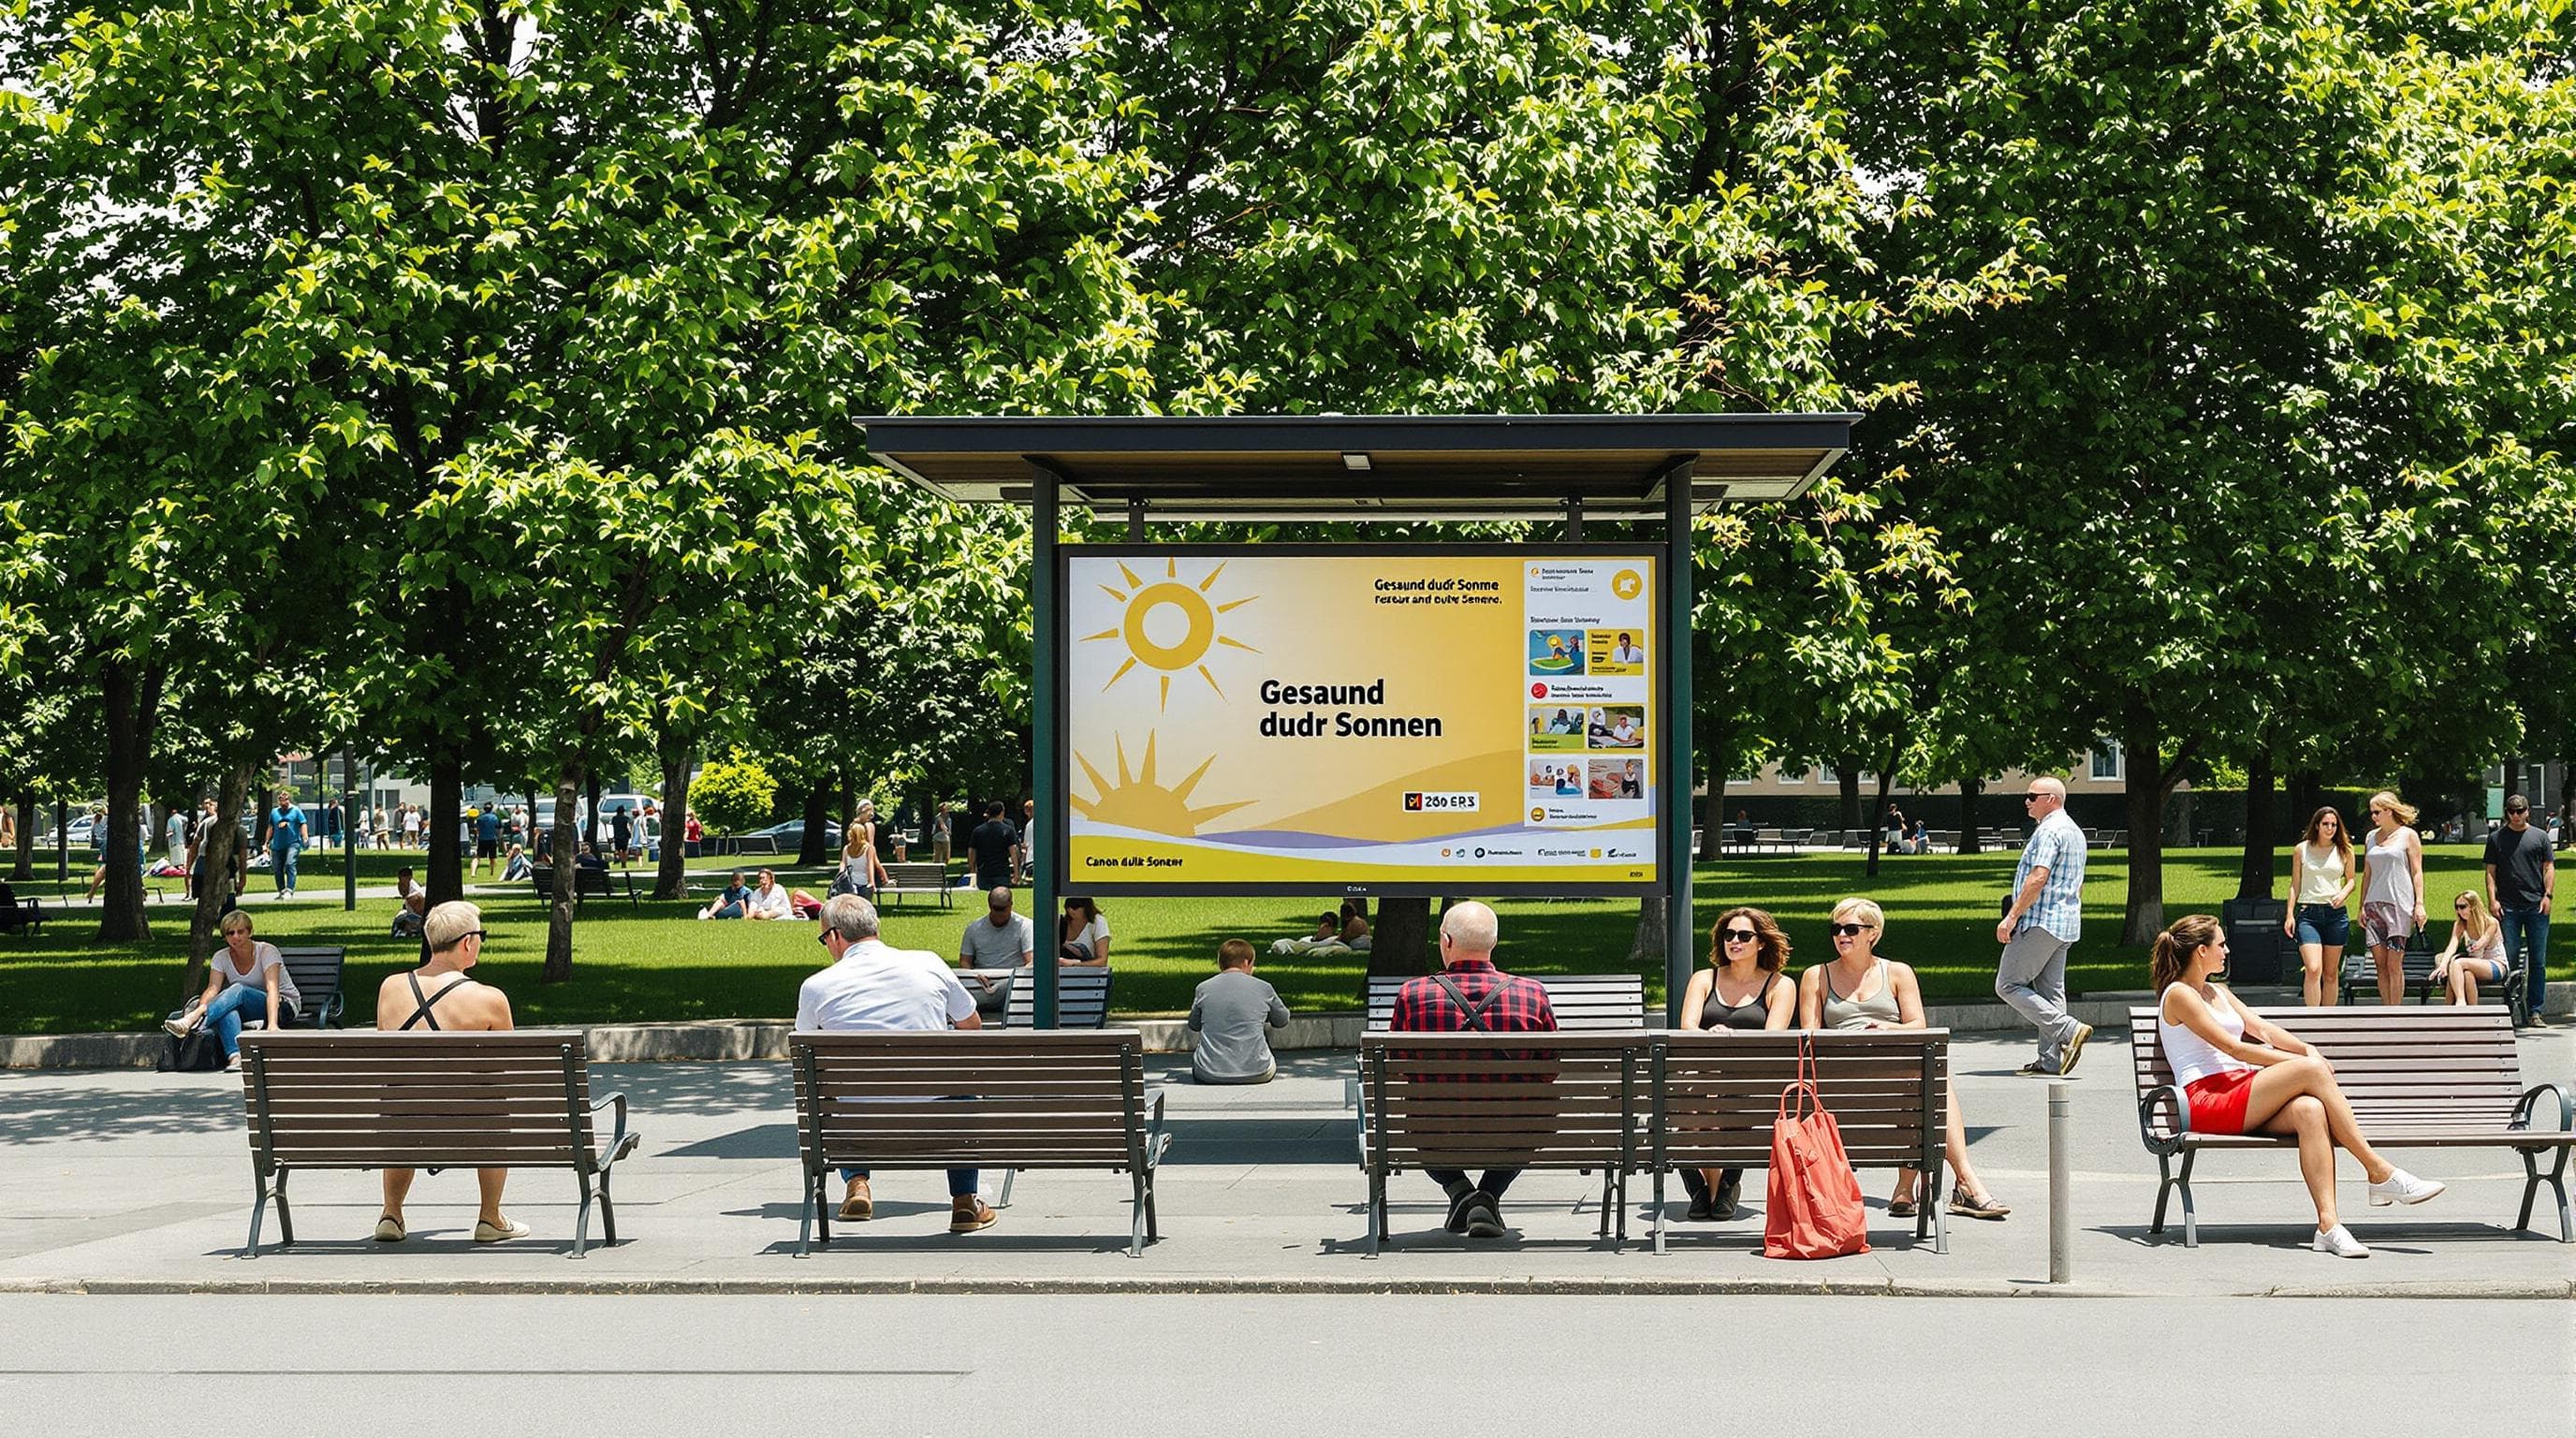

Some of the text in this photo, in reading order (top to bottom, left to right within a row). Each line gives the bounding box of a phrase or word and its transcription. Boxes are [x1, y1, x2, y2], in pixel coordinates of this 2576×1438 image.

[1260, 678, 1384, 706] Gesaund
[1259, 711, 1442, 738] dudr Sonnen
[1086, 856, 1119, 867] Canon
